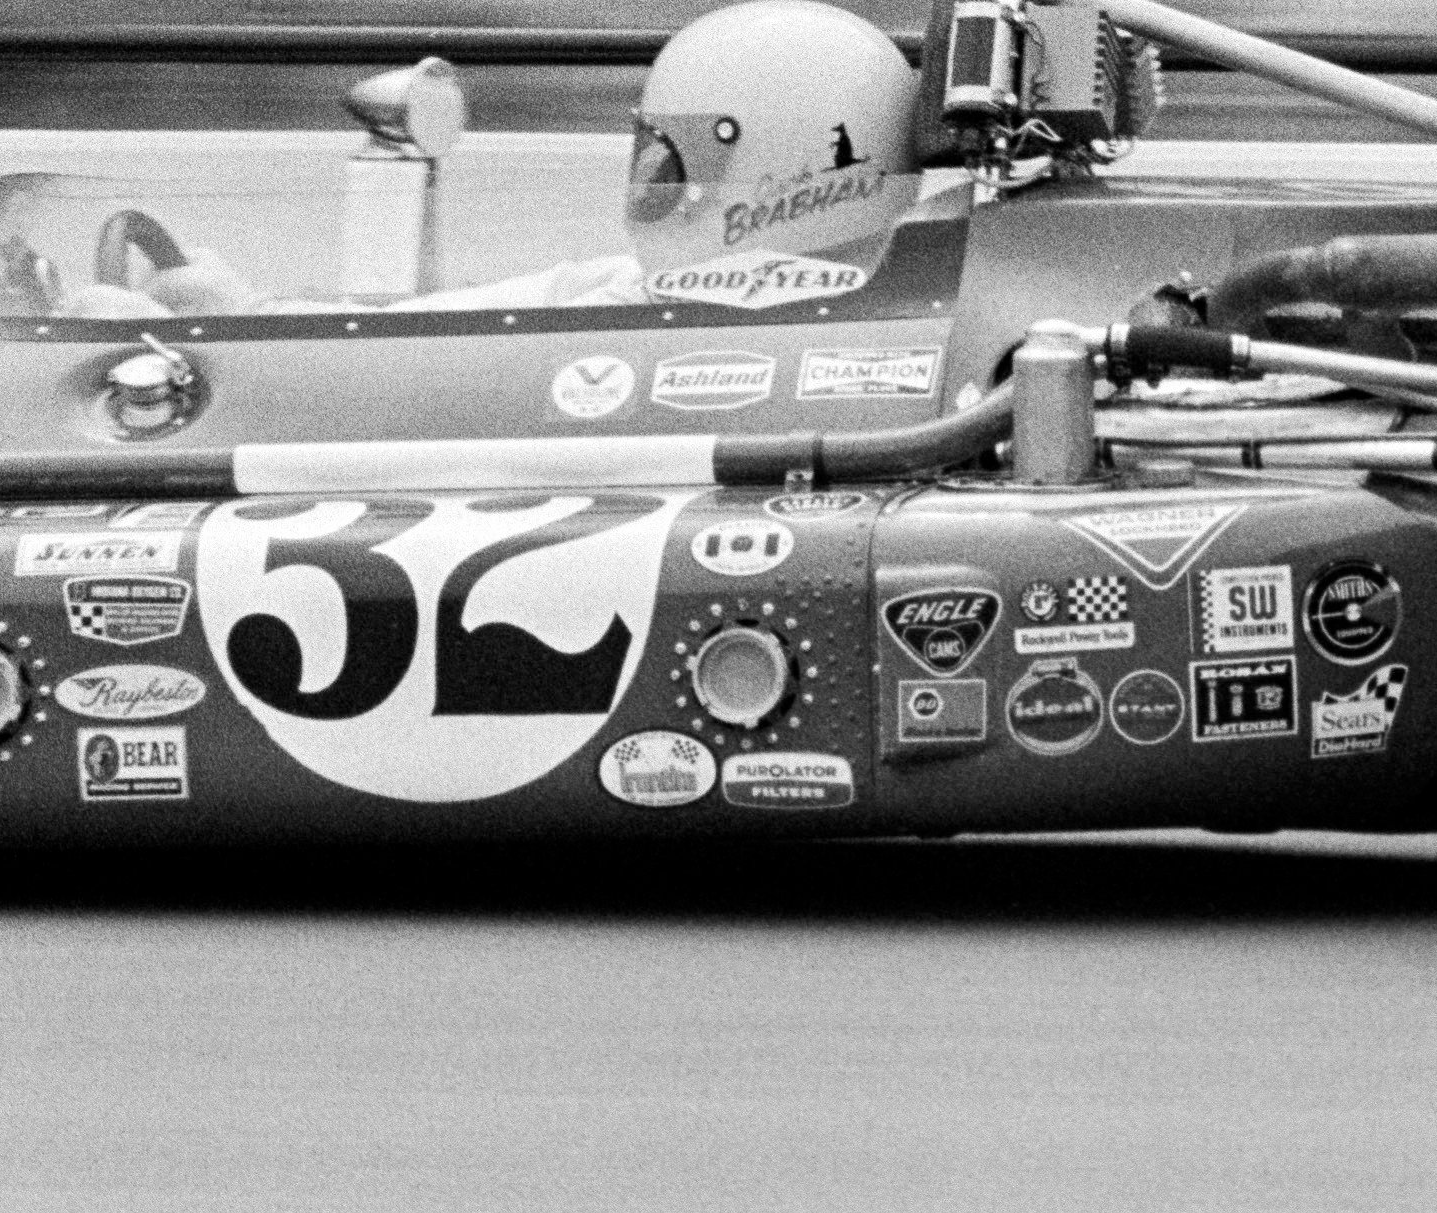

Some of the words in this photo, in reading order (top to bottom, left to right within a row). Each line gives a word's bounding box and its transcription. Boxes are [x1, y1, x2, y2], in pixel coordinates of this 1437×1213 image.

[655, 269, 860, 291] GOODYEAR
[659, 369, 769, 389] Ashland
[810, 363, 929, 381] CHAMPION
[1088, 507, 1217, 527] WAGNER
[226, 494, 666, 721] 32
[897, 597, 988, 625] ENGLE
[1228, 584, 1277, 622] SW
[1219, 622, 1289, 639] INSTRUMENTS
[928, 641, 962, 659] CAMS
[1321, 710, 1381, 733] Sears
[123, 741, 179, 768] BEAR
[735, 764, 838, 779] PUROLATOR
[751, 785, 826, 799] FILTERS
